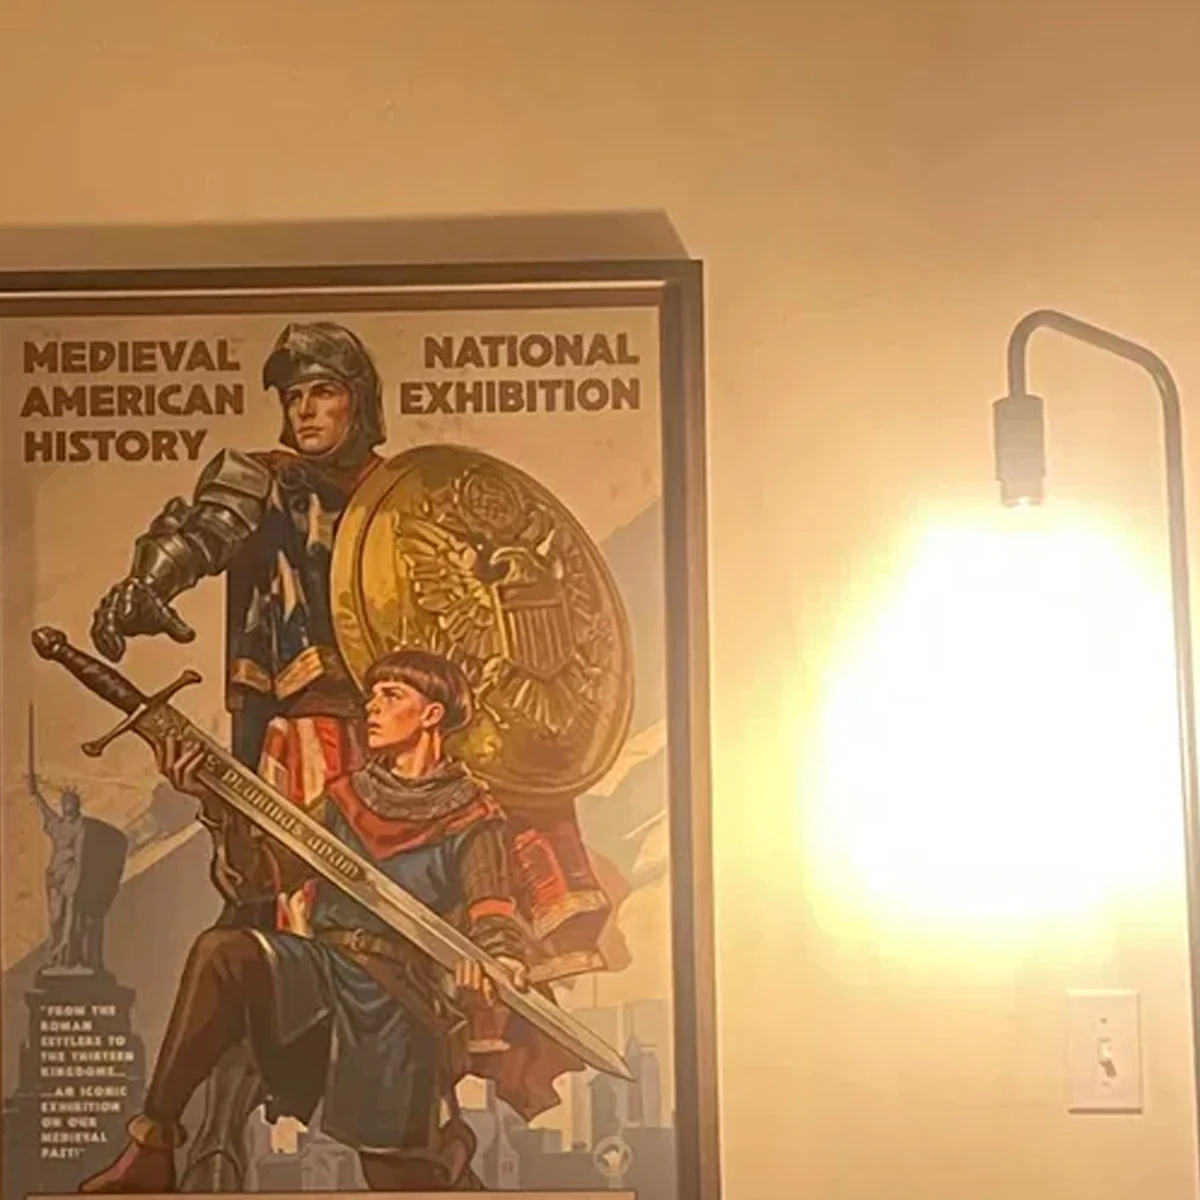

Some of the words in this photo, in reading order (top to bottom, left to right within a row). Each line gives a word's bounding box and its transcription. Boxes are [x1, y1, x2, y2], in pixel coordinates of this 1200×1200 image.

[23, 339, 240, 374] MEDIEVAL
[423, 333, 639, 369] NATIONAL
[20, 384, 244, 418] AMERICAN
[400, 378, 641, 416] EXHIBITION
[24, 429, 206, 463] HISTORY
[92, 1005, 117, 1016] THE
[40, 1021, 92, 1031] ROMAN
[41, 1036, 101, 1047] SETTLERS
[108, 1036, 126, 1047] TO
[41, 1052, 65, 1062] THE
[72, 1051, 134, 1062] THIRTEEN
[80, 1086, 127, 1096] ICONIC
[41, 1102, 120, 1112] EXHIBITION
[41, 1117, 61, 1128] ON
[68, 1117, 97, 1128] OUR
[41, 1132, 107, 1143] MEDIEVAL
